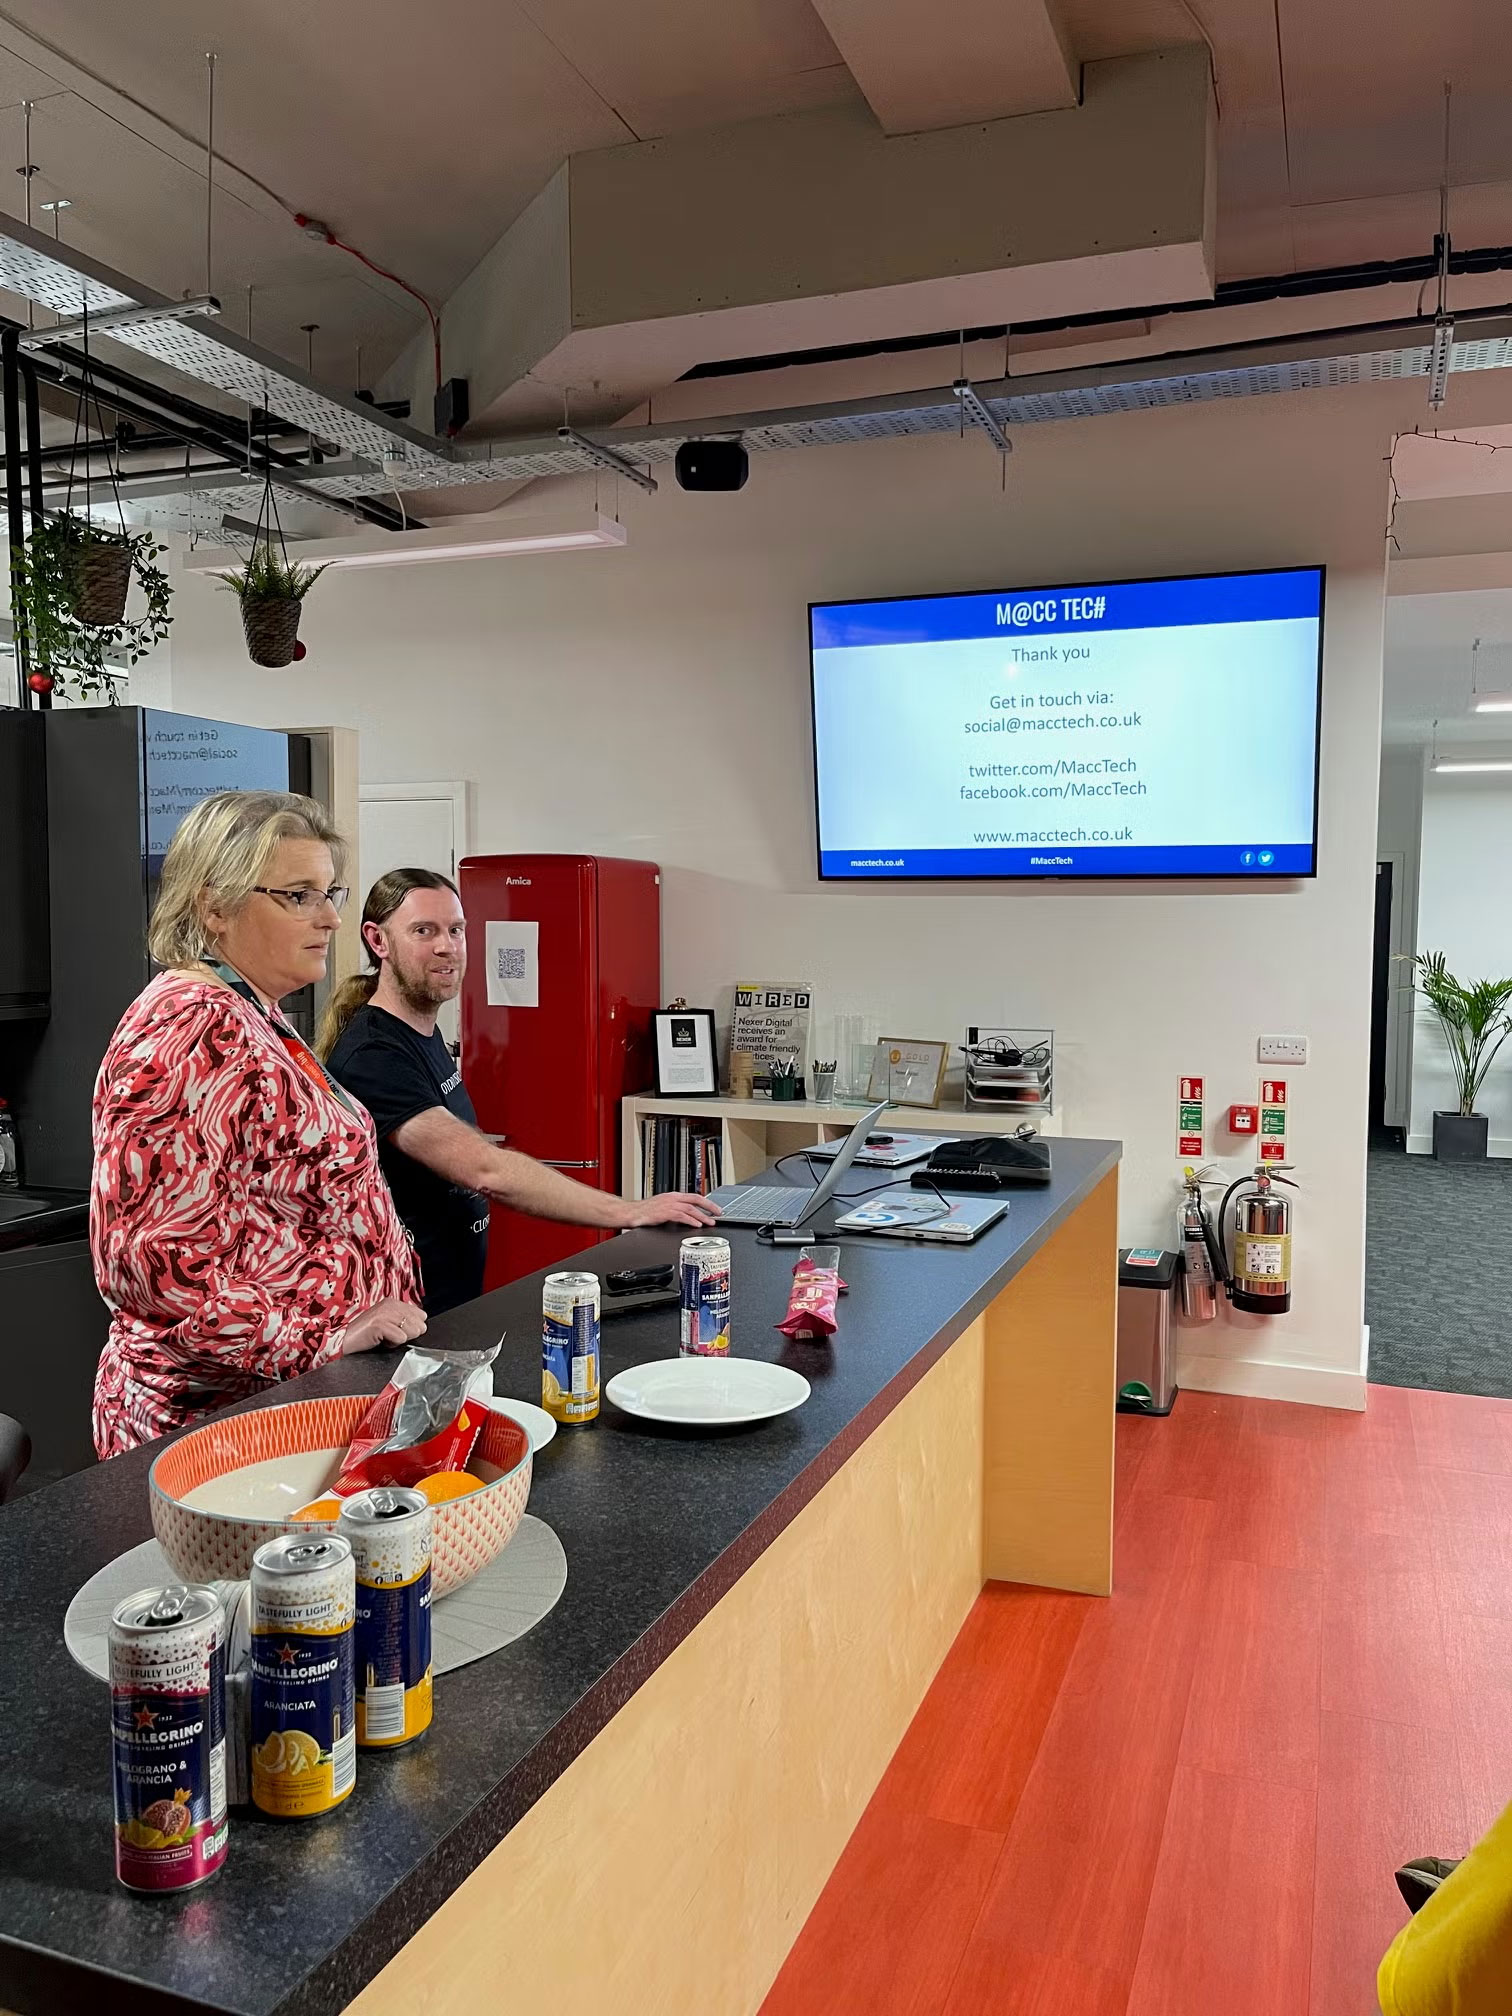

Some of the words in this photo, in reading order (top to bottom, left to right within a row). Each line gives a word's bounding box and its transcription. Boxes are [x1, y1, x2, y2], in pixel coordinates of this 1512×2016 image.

[996, 600, 1056, 626] M@CC
[1061, 596, 1106, 620] TEC#
[1011, 646, 1058, 662] Thank
[1062, 647, 1090, 662] you
[990, 696, 1016, 709] Get
[1021, 694, 1034, 707] in
[1039, 691, 1082, 706] touch
[1087, 691, 1114, 704] via:
[964, 711, 1142, 734] social@macctech.co.uk
[969, 758, 1137, 777] twitter.com/MaccTech
[960, 780, 1147, 800] facebook.com/MaccTech
[973, 826, 1133, 843] www.macctech.co.uk
[850, 858, 904, 867] macctech.co.uk
[1030, 856, 1073, 865] #MaccTech
[505, 876, 532, 886] Amica
[735, 991, 810, 1009] WIRED
[738, 1017, 764, 1026] Nexer
[765, 1018, 793, 1028] Digital
[737, 1027, 773, 1035] receives
[774, 1028, 786, 1036] an
[737, 1035, 763, 1043] award
[765, 1035, 777, 1043] for
[736, 1044, 767, 1052] climate
[769, 1044, 801, 1054] friendly
[306, 1603, 331, 1616] LIGHT
[166, 1662, 195, 1676] LIGHT
[251, 1657, 339, 1679] ANPELLEGRINO
[264, 1700, 316, 1711] ARANCIATA
[179, 1760, 187, 1770] &
[126, 1774, 172, 1785] ARANCIA
